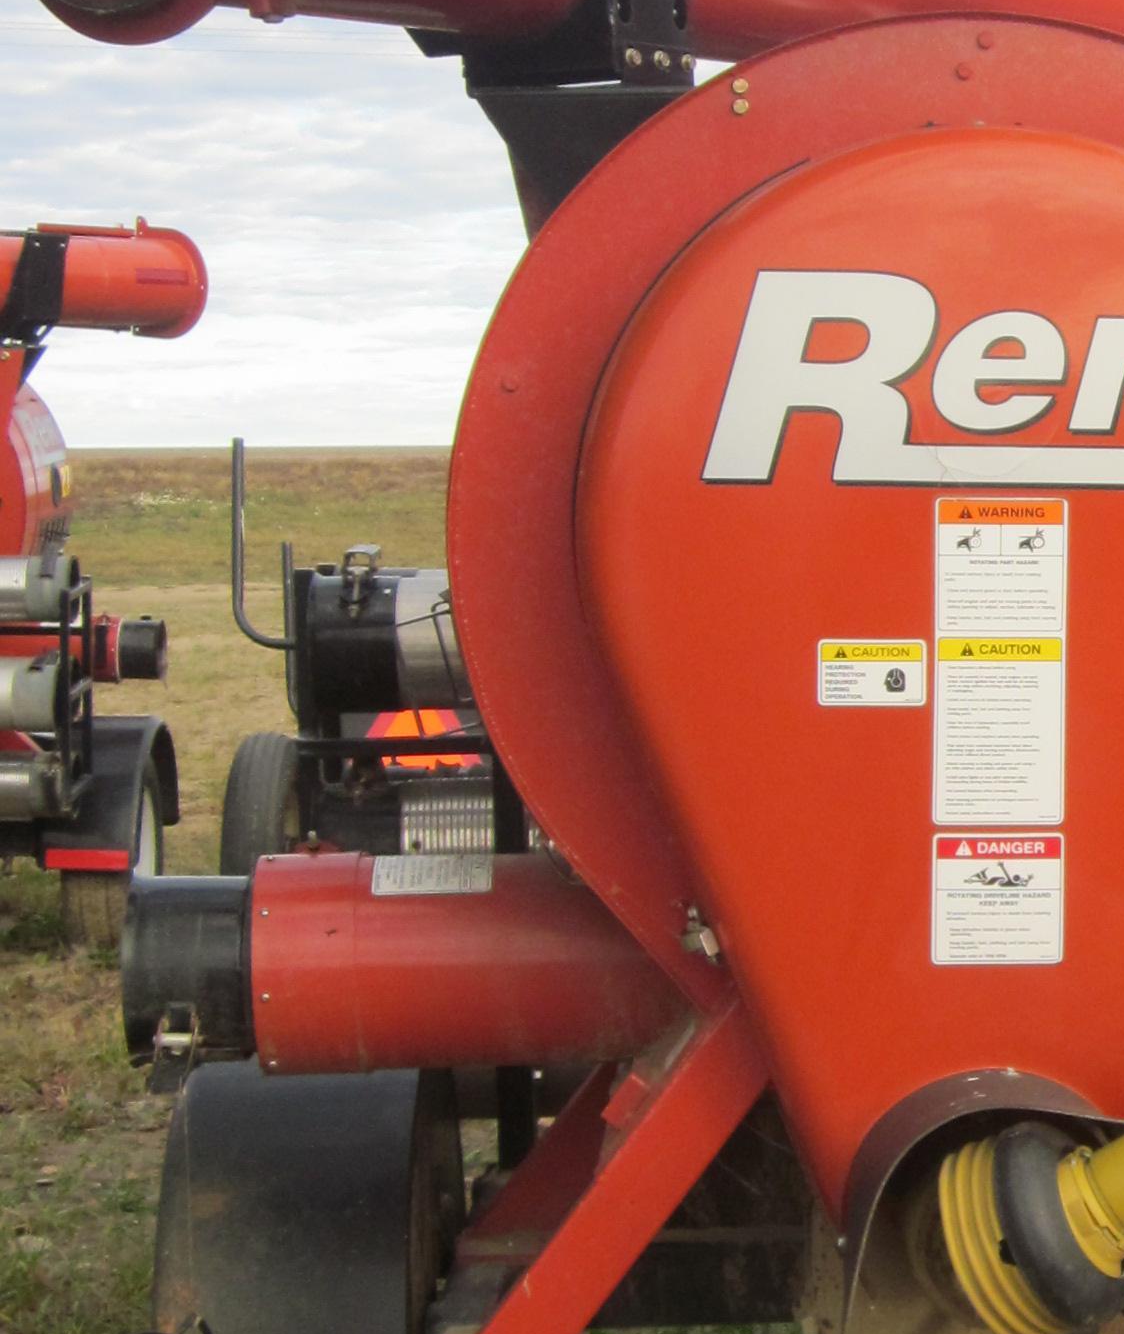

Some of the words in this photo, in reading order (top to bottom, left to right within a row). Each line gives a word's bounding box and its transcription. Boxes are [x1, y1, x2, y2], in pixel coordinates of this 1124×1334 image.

[978, 507, 1045, 518] WARNING
[851, 647, 910, 657] CAUTION
[979, 643, 1042, 655] CAUTION
[976, 841, 1045, 854] DANGER
